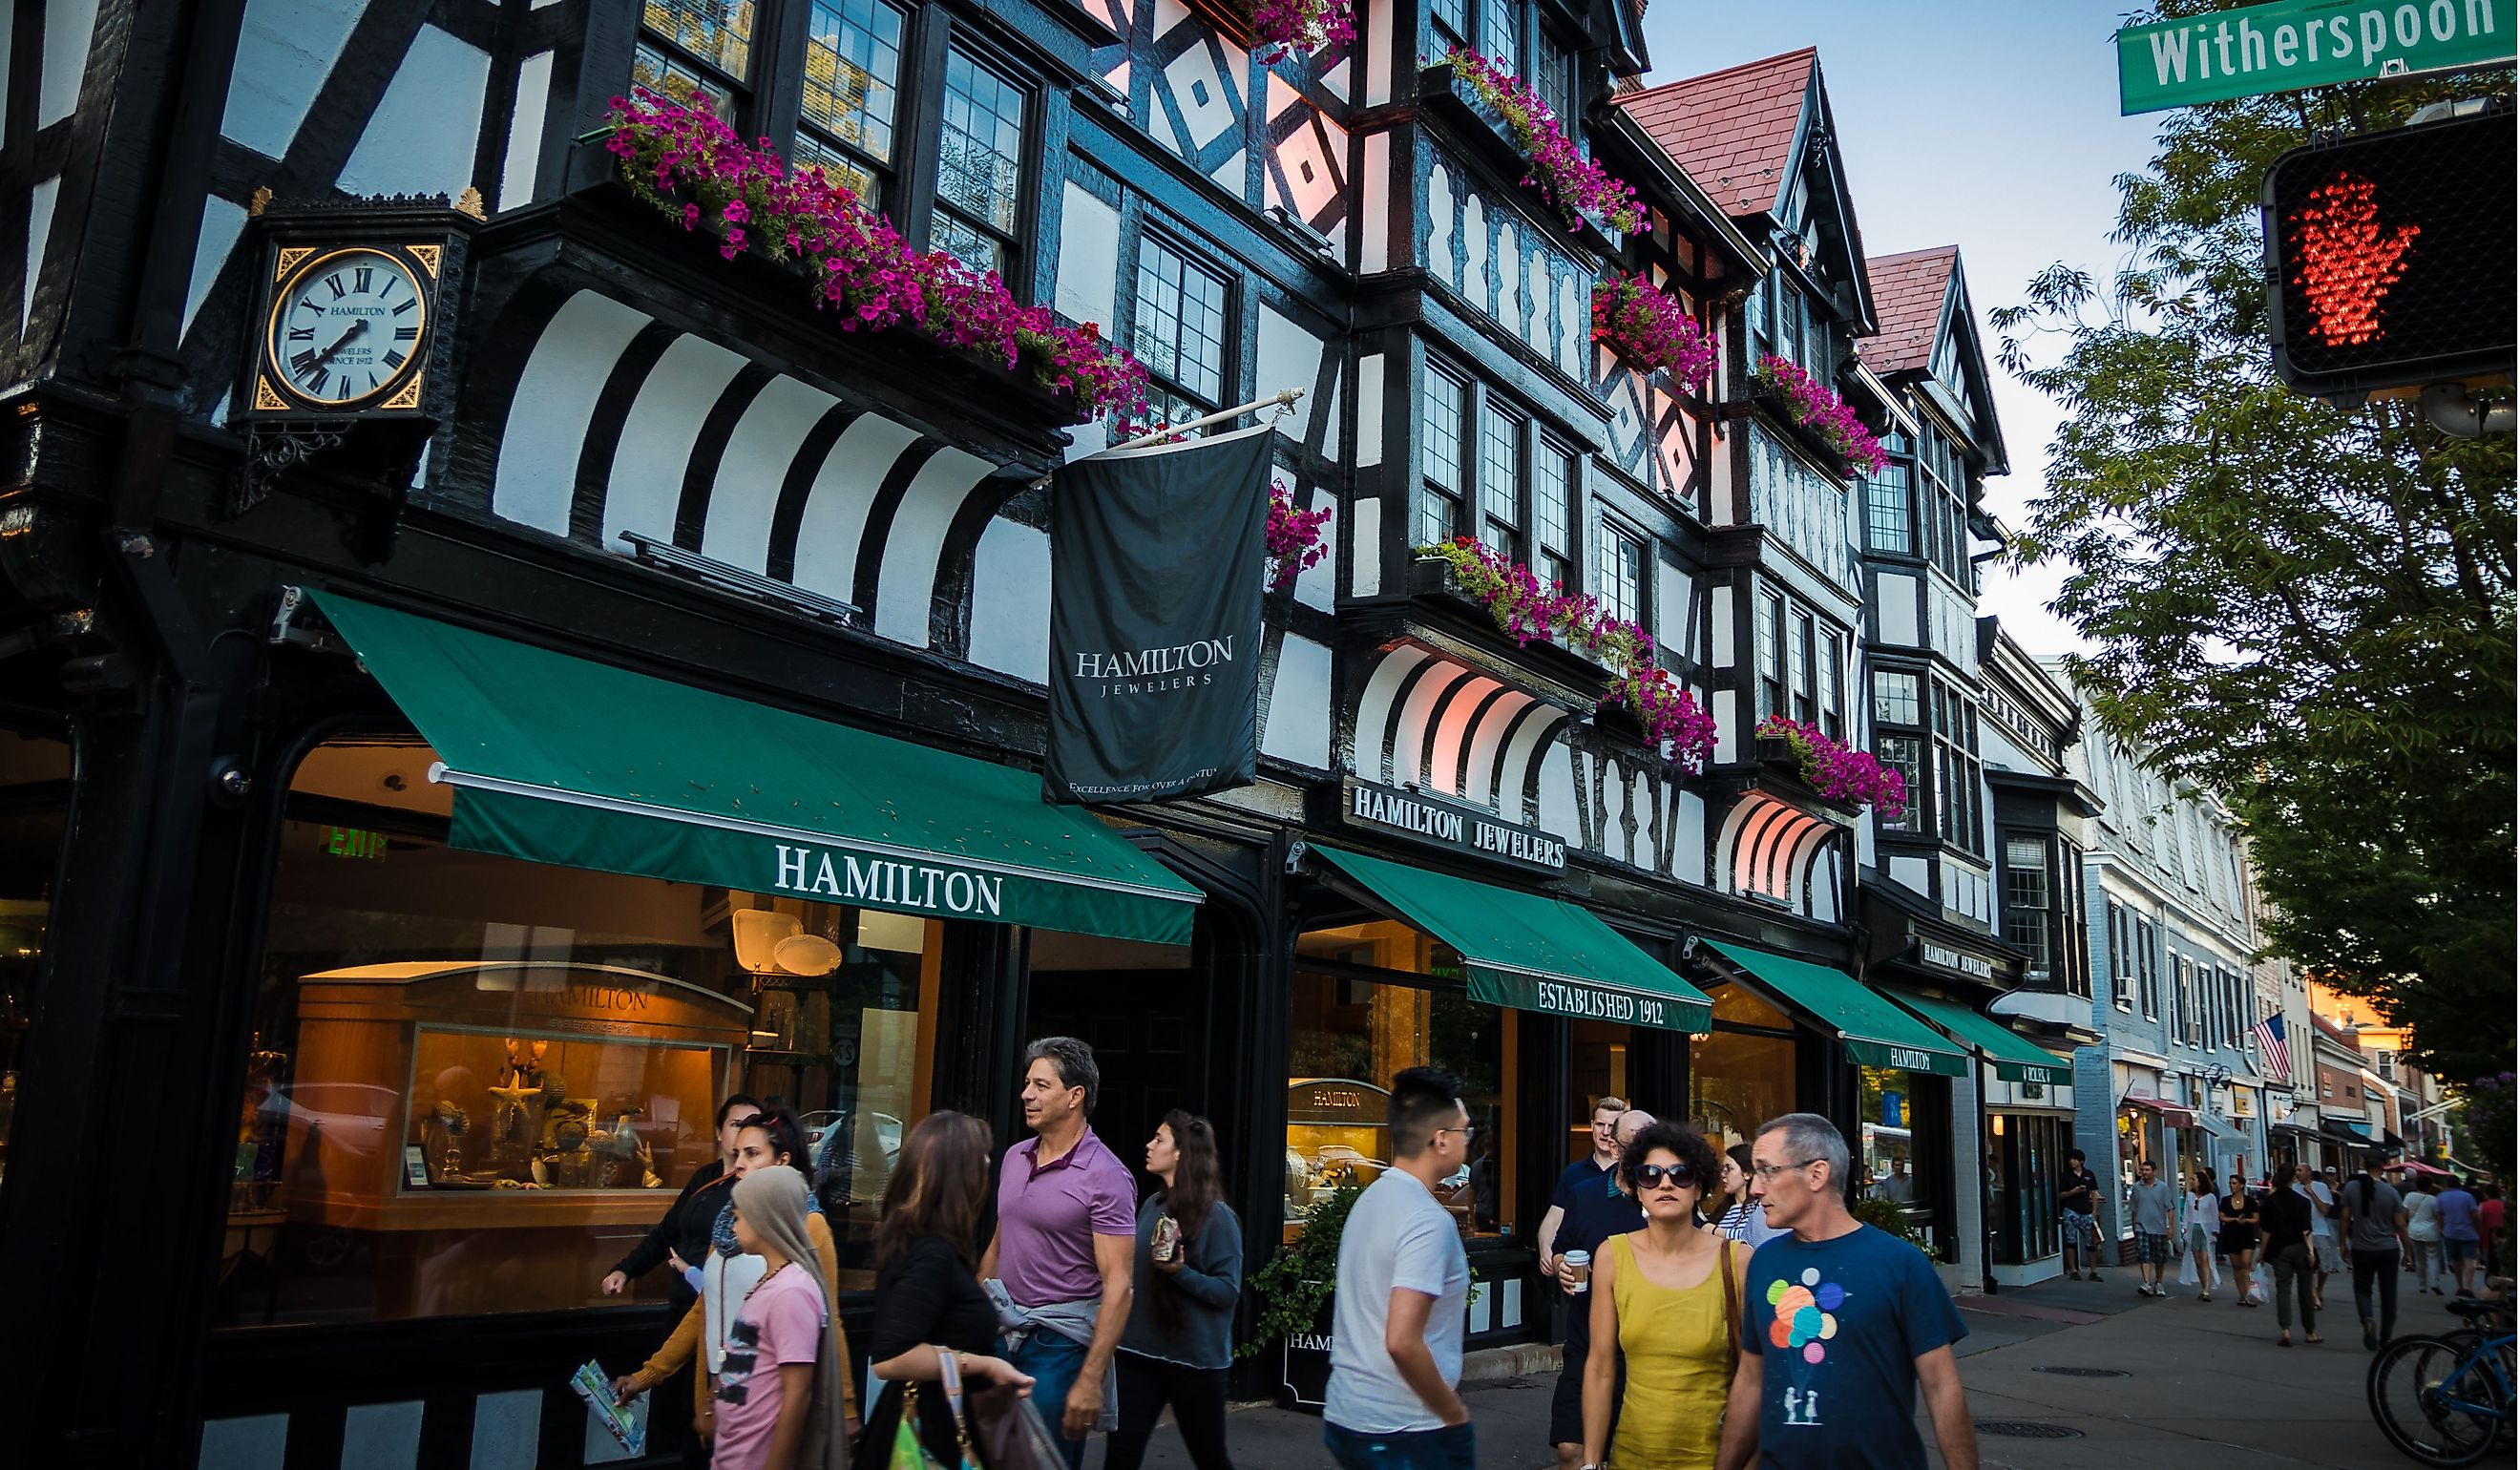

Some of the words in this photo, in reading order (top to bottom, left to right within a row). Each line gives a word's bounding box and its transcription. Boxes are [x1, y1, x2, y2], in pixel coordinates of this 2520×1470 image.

[2150, 0, 2494, 86] Witherspoon
[325, 273, 346, 302] XI
[352, 268, 373, 293] XII
[379, 276, 399, 299] I
[301, 297, 326, 317] X
[330, 307, 386, 316] HAMILTON
[391, 297, 418, 317] II
[394, 326, 419, 341] III
[1075, 635, 1233, 679] HAMILTON
[1101, 674, 1212, 698] JEWELERS
[1354, 786, 1463, 842] HAMILTON
[1474, 820, 1564, 869] JEWELERS
[774, 844, 1003, 916] HAMILTON
[1924, 943, 1959, 969] HAMILTON
[1961, 955, 1991, 979] JEWELERS
[535, 984, 649, 1011] HAMILTON
[1538, 981, 1633, 1020] ESTABLISHED
[1638, 998, 1664, 1024] 1912
[1890, 1047, 1930, 1071] HAMILTON
[1313, 1090, 1360, 1107] HAMILTON
